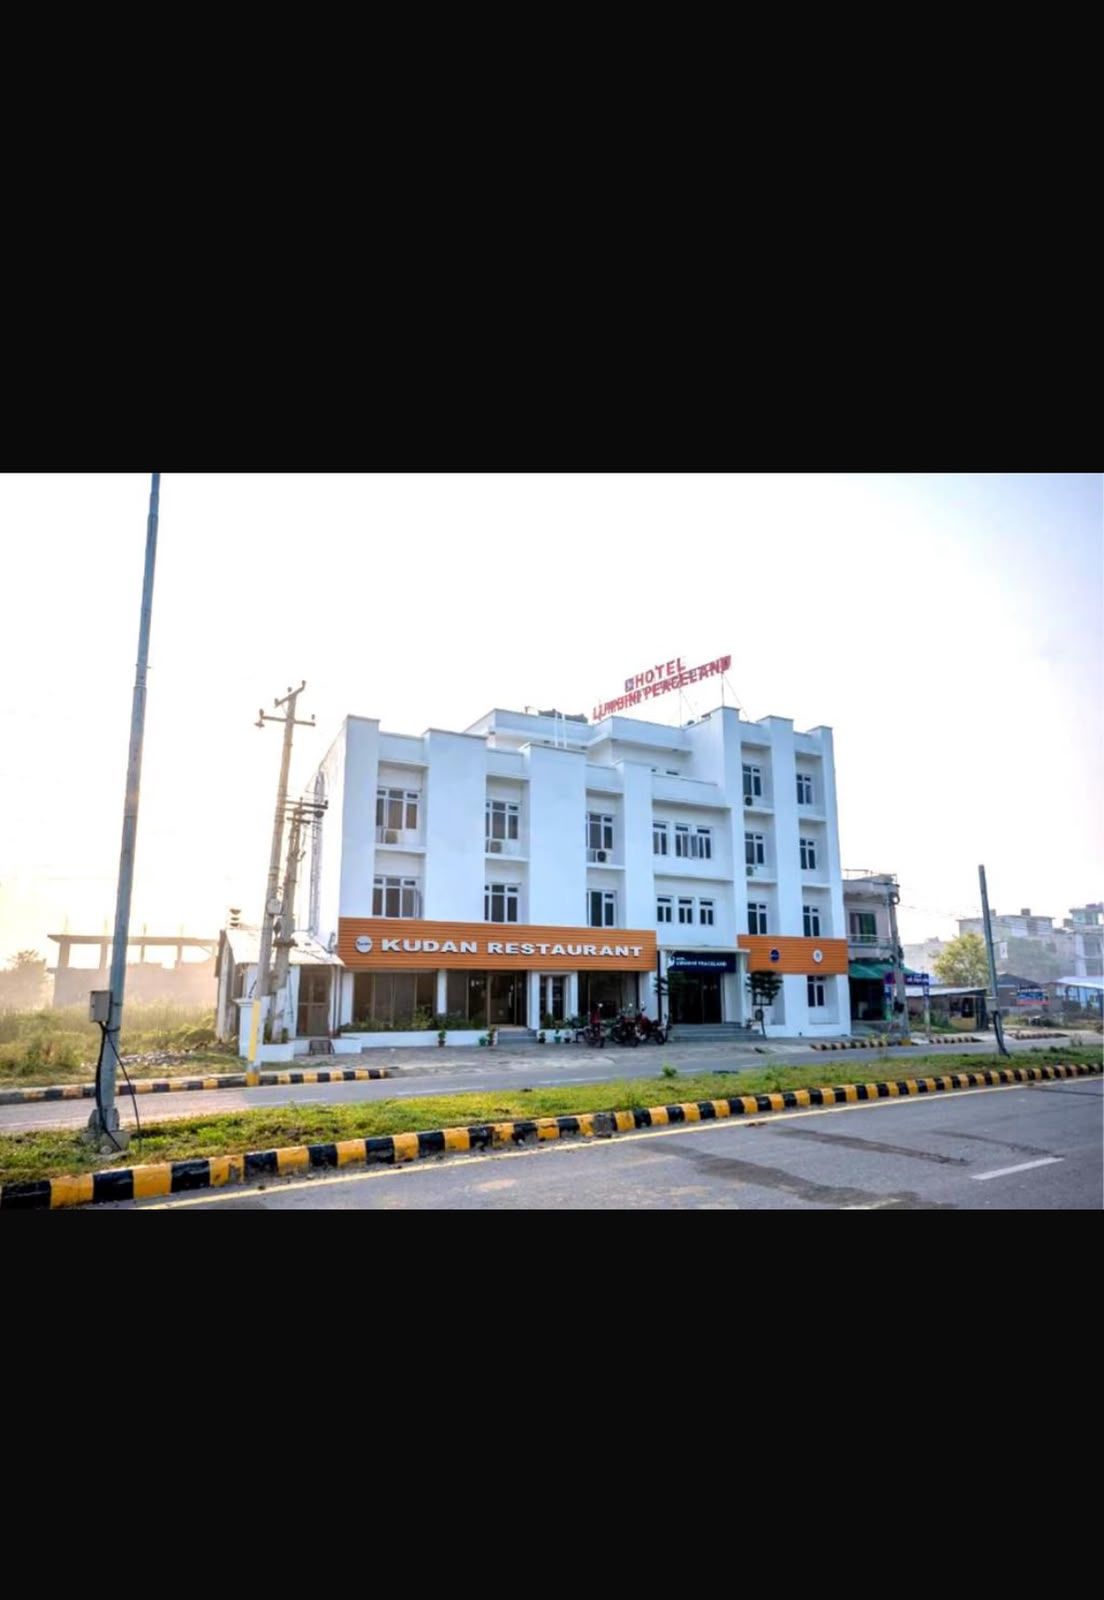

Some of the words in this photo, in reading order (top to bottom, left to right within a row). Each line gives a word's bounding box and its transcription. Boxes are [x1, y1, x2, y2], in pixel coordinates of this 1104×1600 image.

[635, 657, 686, 688] HOTEL
[644, 654, 732, 701] PEACELAND
[381, 939, 477, 954] KUDAN
[488, 942, 643, 957] RESTAURANT
